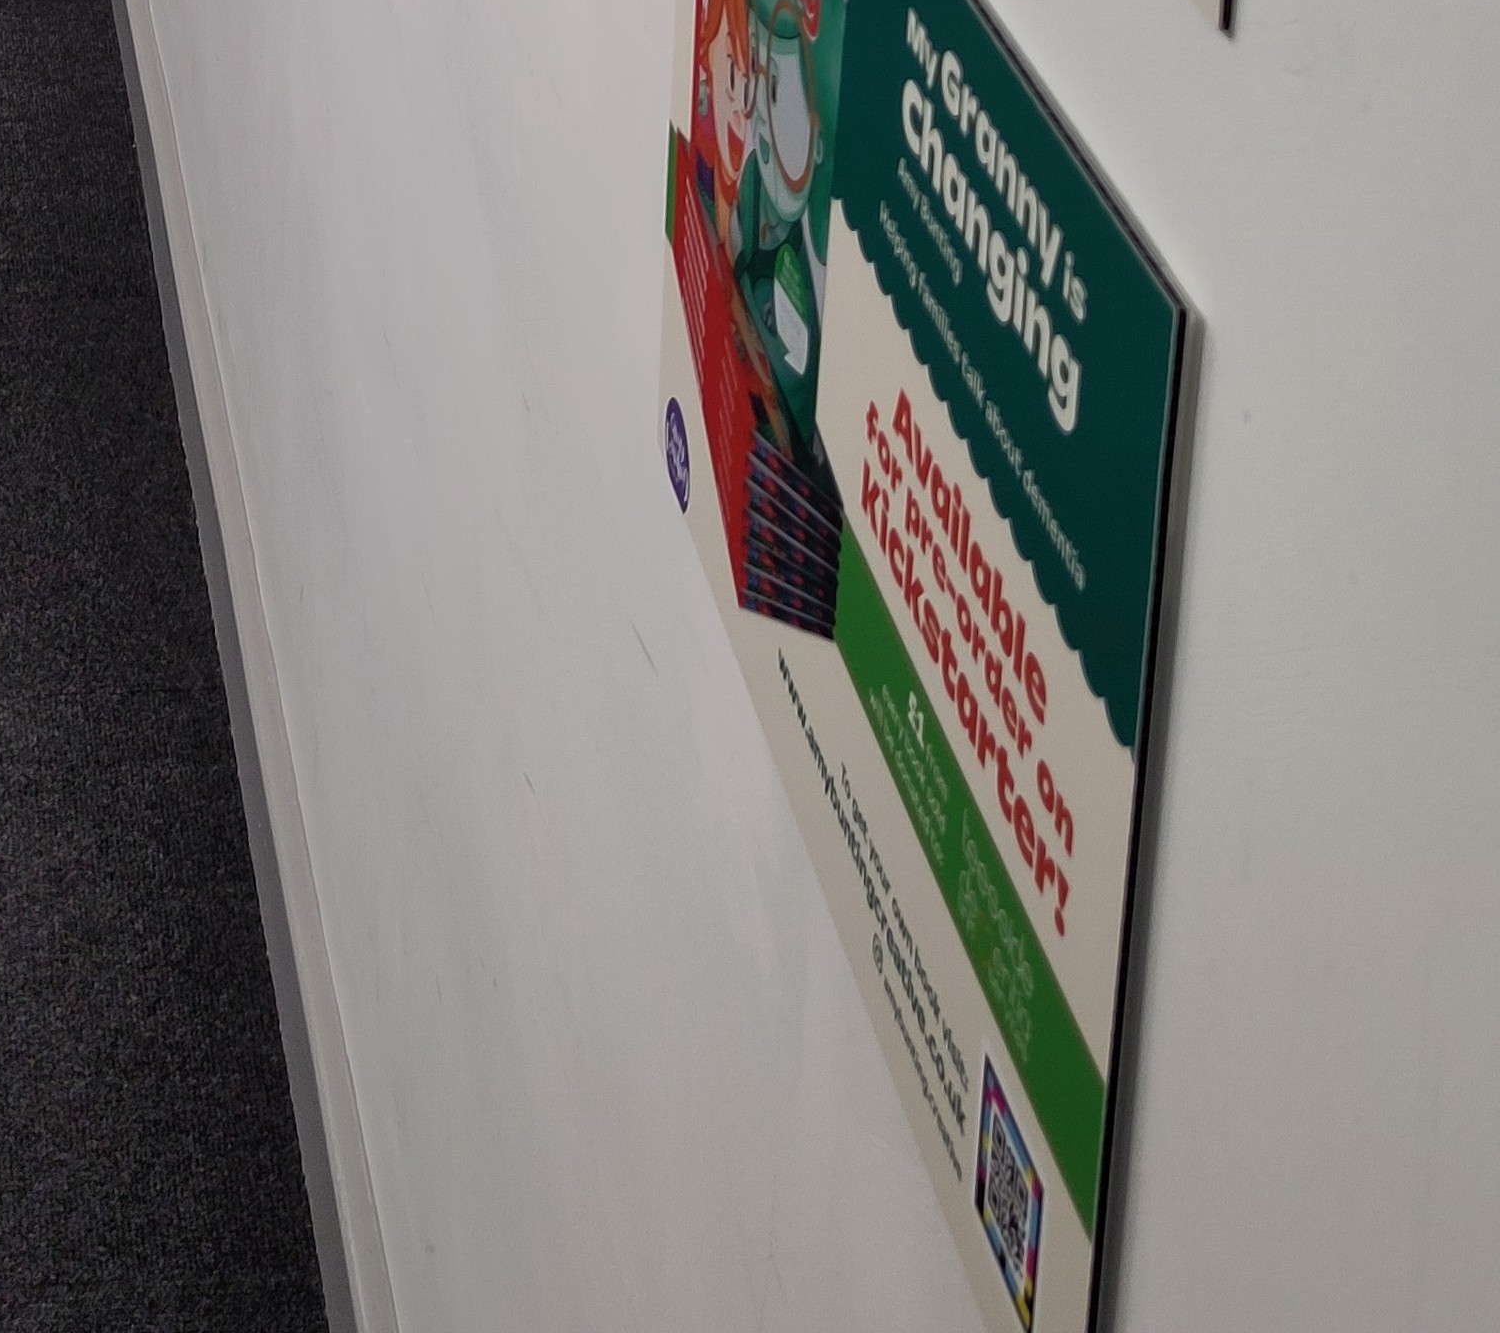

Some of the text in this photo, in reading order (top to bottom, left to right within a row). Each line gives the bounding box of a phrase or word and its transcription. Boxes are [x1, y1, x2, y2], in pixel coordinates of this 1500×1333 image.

[897, 152, 962, 290] Amy Bunting
[902, 71, 1080, 437] Changing
[906, 10, 1087, 326] My Granny is
[879, 196, 1085, 594] Helping families talk about dementia
[893, 381, 1047, 719] Available
[862, 464, 1067, 934] Kickstarter!
[866, 399, 1073, 848] for pre-order on
[908, 691, 925, 748] £1
[778, 656, 965, 1131] www.amybuntingcreative.co.uk
[840, 763, 968, 1094] To get your own book visit:
